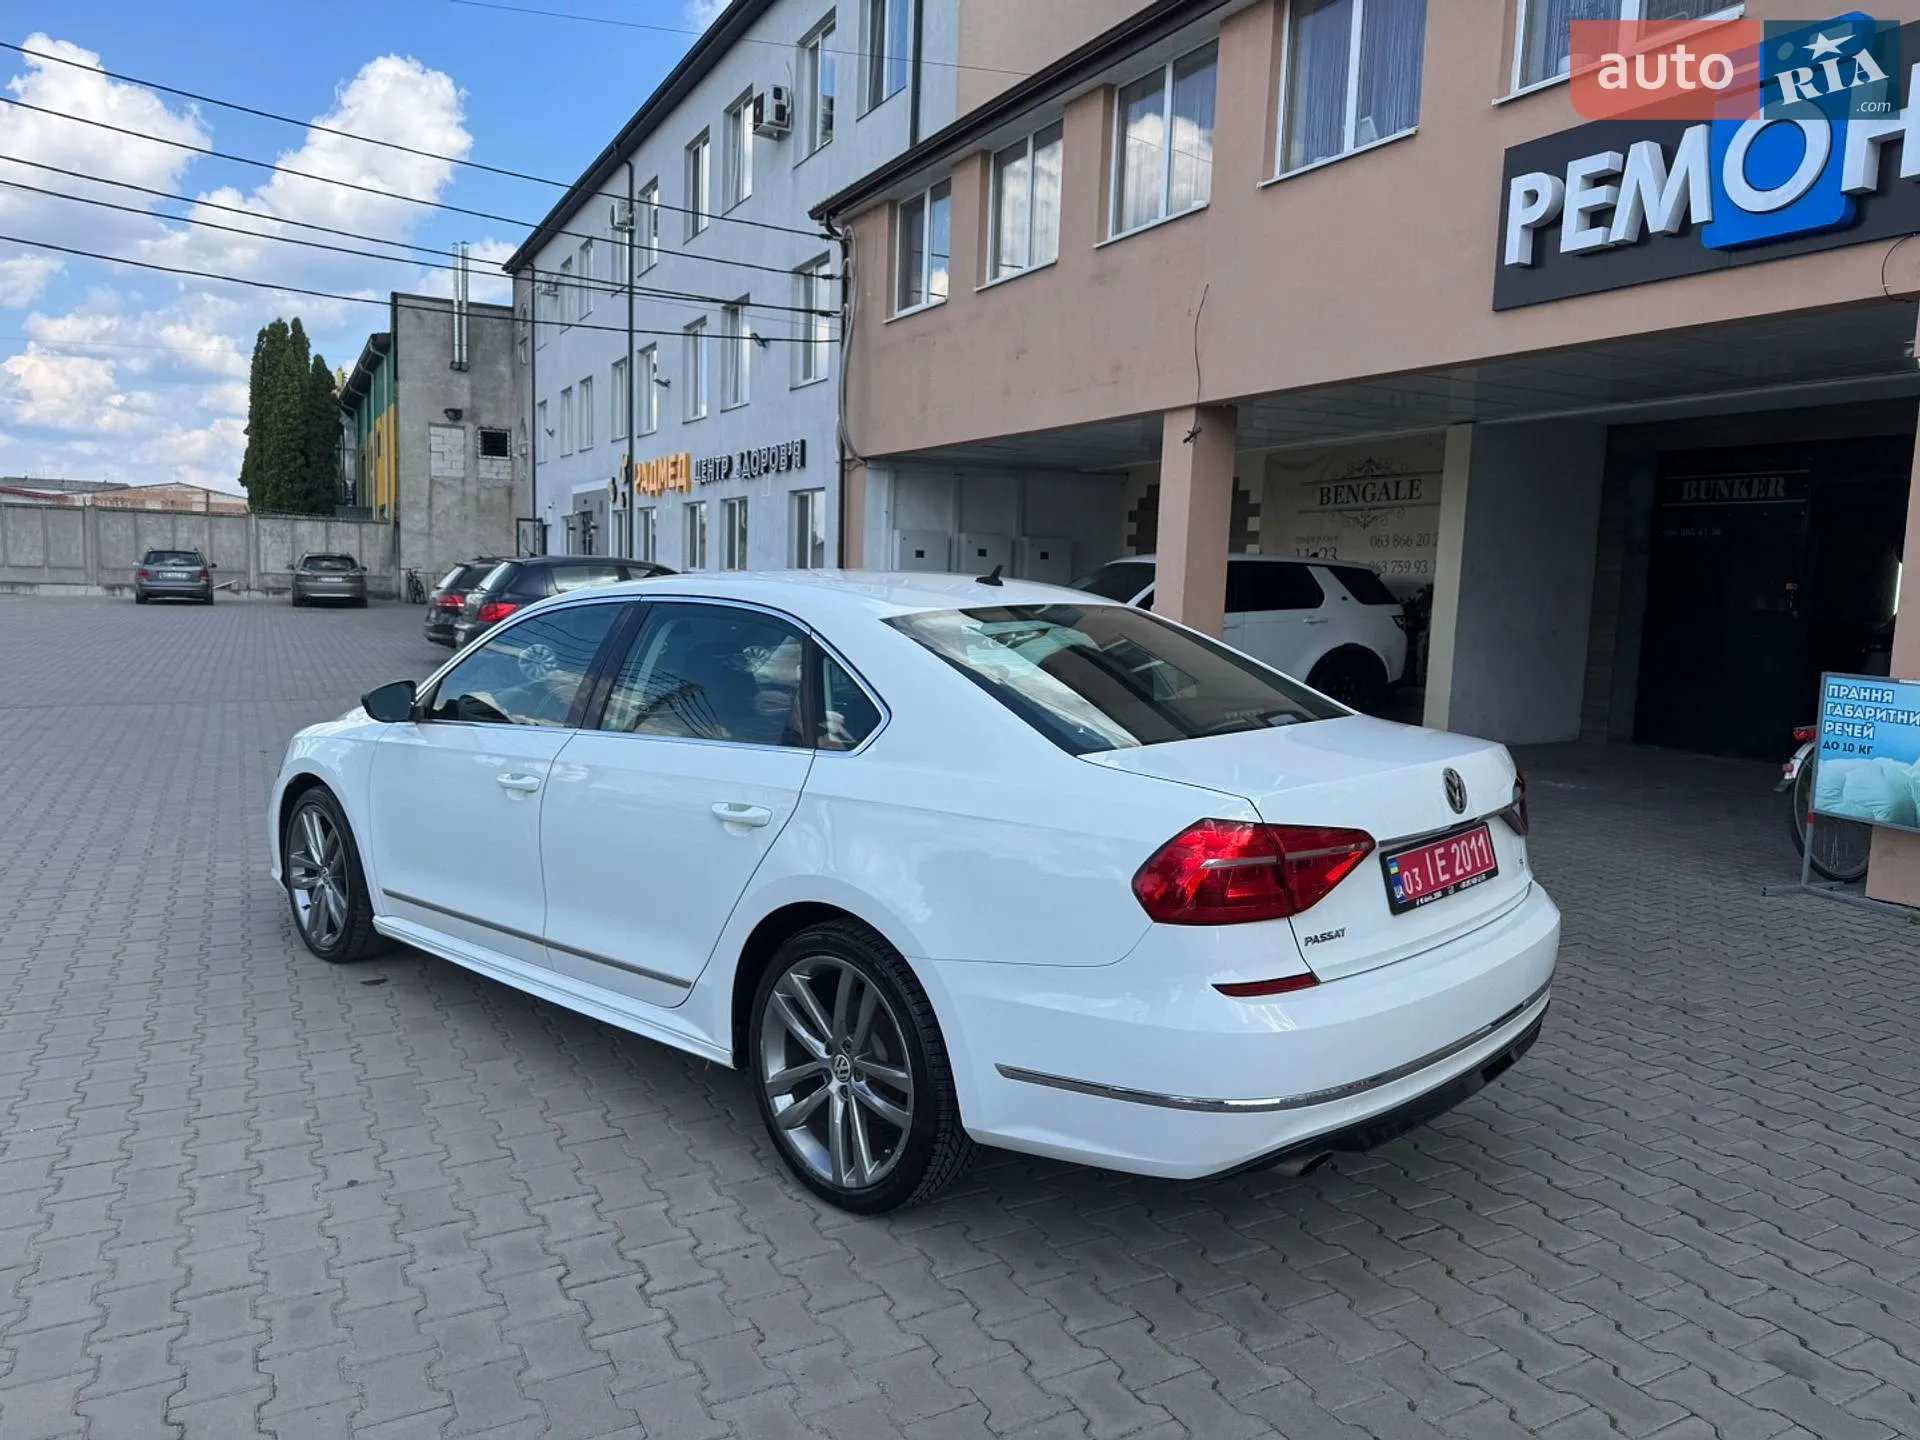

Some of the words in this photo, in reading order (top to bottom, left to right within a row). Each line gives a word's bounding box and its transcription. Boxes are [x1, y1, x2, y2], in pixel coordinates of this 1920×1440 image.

[694, 454, 732, 485] ЦЕНТР
[1318, 478, 1423, 507] BENGALE
[1680, 476, 1787, 501] BUNKER
[1827, 684, 1895, 704] ПРАННЯ
[1824, 720, 1876, 741] РЕЧЕЙ
[1822, 739, 1840, 751] ДО
[1842, 741, 1855, 753] 10
[1858, 743, 1874, 756] КГ
[1403, 867, 1423, 895] 03
[1450, 833, 1490, 876] 2011
[1303, 927, 1347, 947] PASSAT
